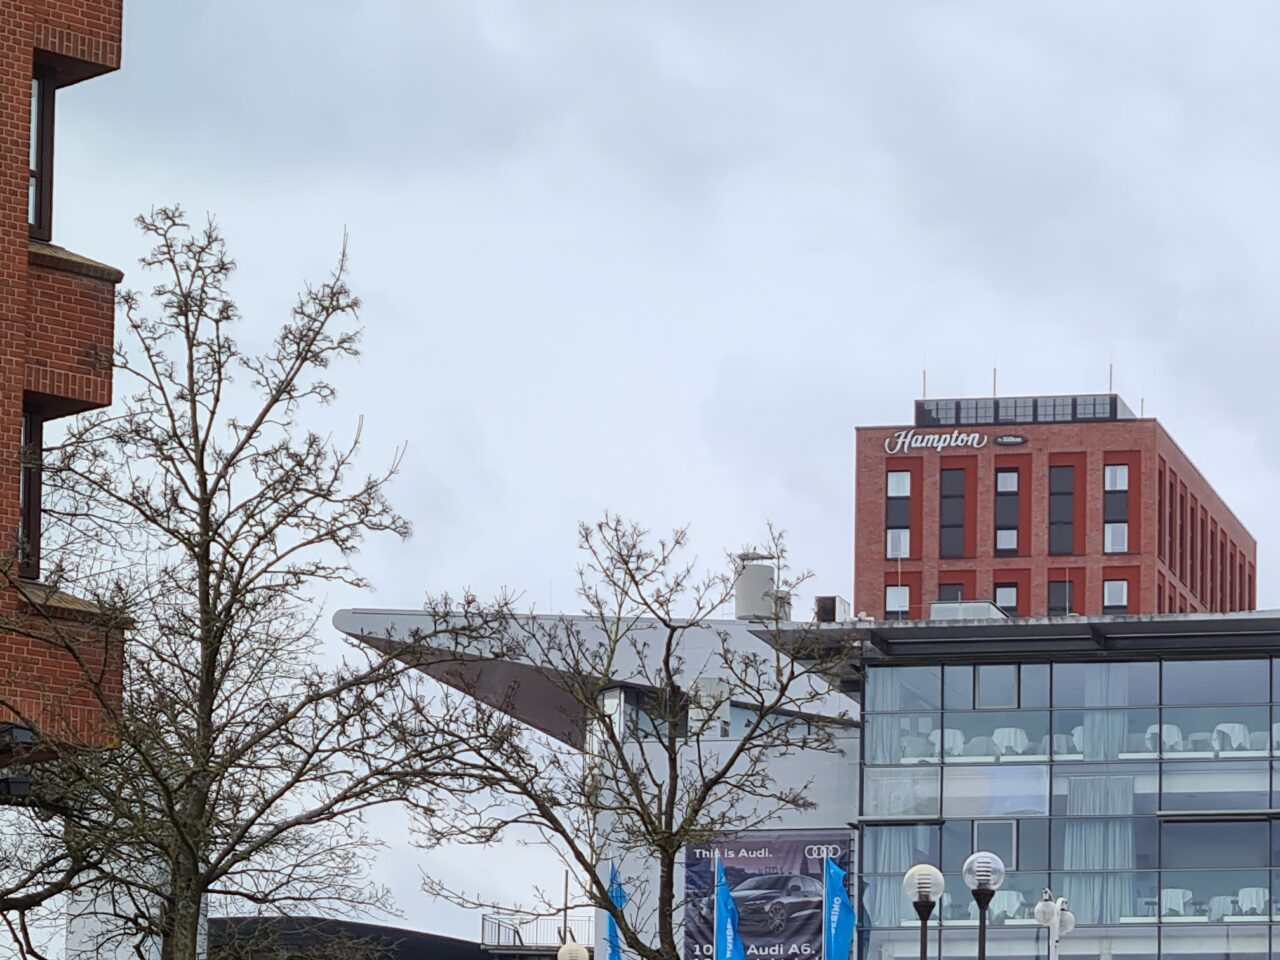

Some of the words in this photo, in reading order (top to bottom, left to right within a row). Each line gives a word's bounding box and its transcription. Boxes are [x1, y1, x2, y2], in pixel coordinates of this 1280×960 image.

[884, 429, 988, 454] Hampton
[724, 848, 735, 858] is
[738, 848, 773, 858] Audi.
[746, 944, 784, 955] Audi
[788, 944, 816, 955] A6.
